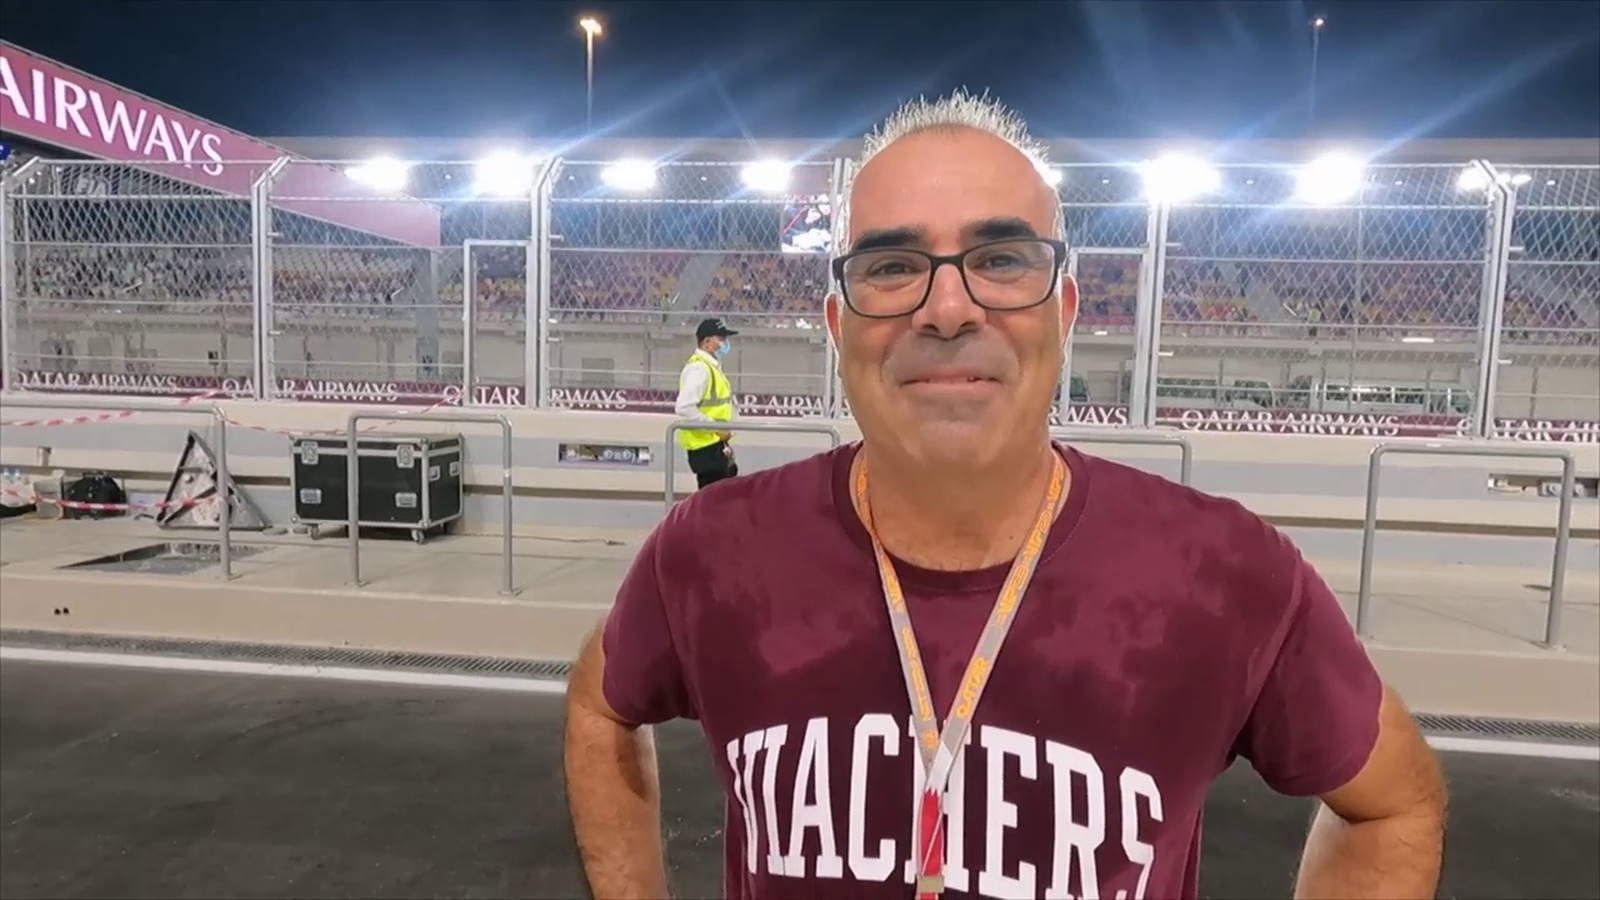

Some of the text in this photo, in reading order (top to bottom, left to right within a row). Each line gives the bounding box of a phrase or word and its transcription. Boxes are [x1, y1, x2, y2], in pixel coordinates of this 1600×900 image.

[0, 57, 224, 177] AIRWAYS
[88, 372, 178, 394] AIRWAYS
[302, 380, 398, 402] AIRWAYS
[1182, 408, 1399, 436] QATAR AIRWAYS
